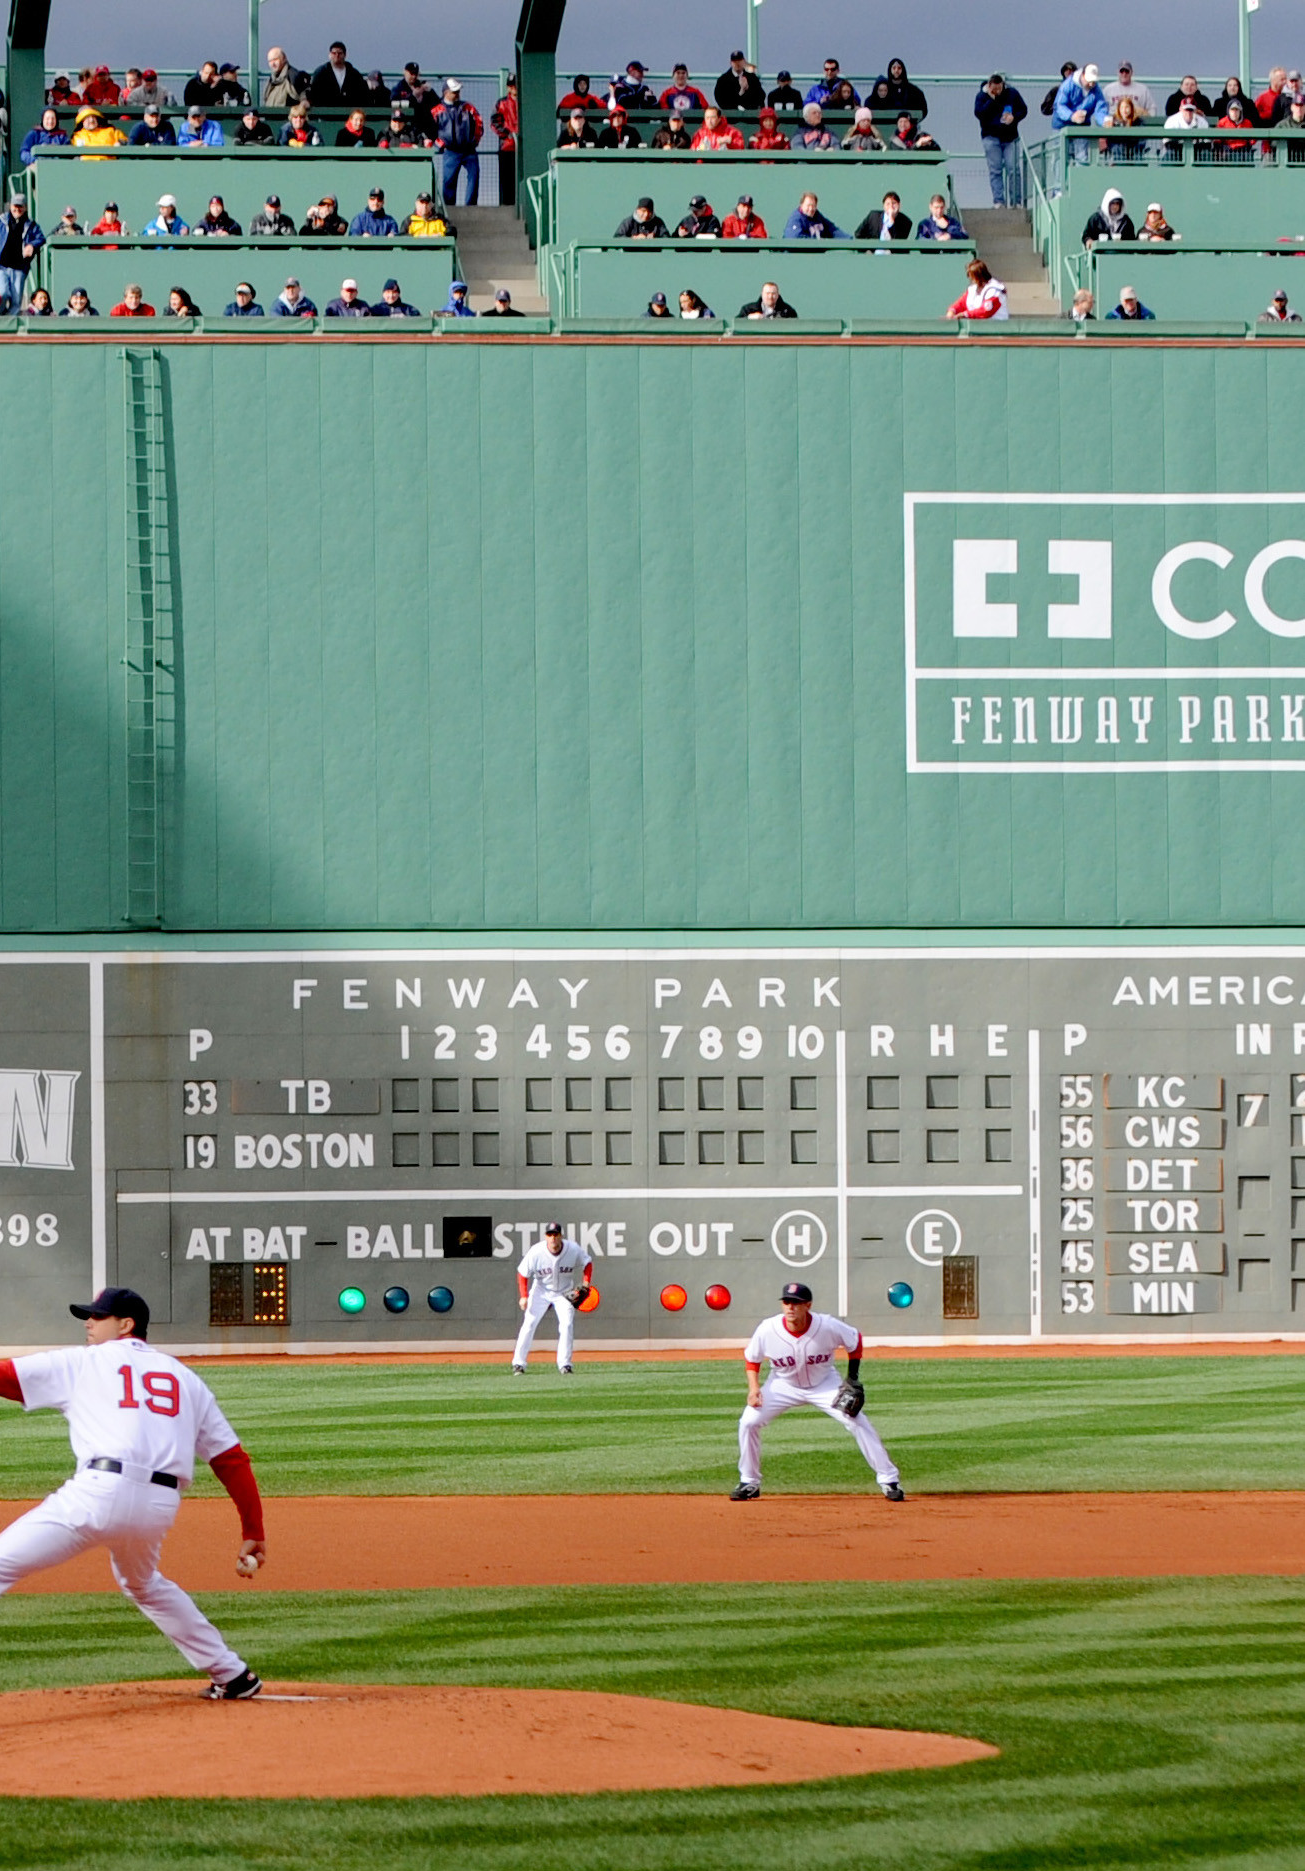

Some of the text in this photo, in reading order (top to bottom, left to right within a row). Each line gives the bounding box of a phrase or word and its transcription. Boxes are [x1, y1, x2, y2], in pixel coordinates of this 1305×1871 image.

[952, 695, 1305, 744] FENWAY PARK
[1113, 976, 1305, 1005] AMERIC
[190, 1024, 1008, 1061] P 1 2 3 4 5 6 7 8 9 10 R H E
[1065, 1024, 1087, 1055] P
[1236, 1024, 1271, 1054] IN
[185, 1080, 331, 1115] 33 TB
[1061, 1075, 1263, 1127] 55 KC 7
[1061, 1116, 1200, 1148] 56 CWS
[187, 1133, 374, 1169] 19 BOSTON
[1061, 1158, 1197, 1191] 36 DET
[1062, 1200, 1198, 1231] 25 TOR
[186, 1222, 943, 1260] AT BAT BALL STIKE OUT H E
[1062, 1242, 1198, 1273] 45 SEA
[255, 1267, 284, 1320] 3
[1063, 1282, 1193, 1313] 53 MIN
[118, 1364, 180, 1417] 19
